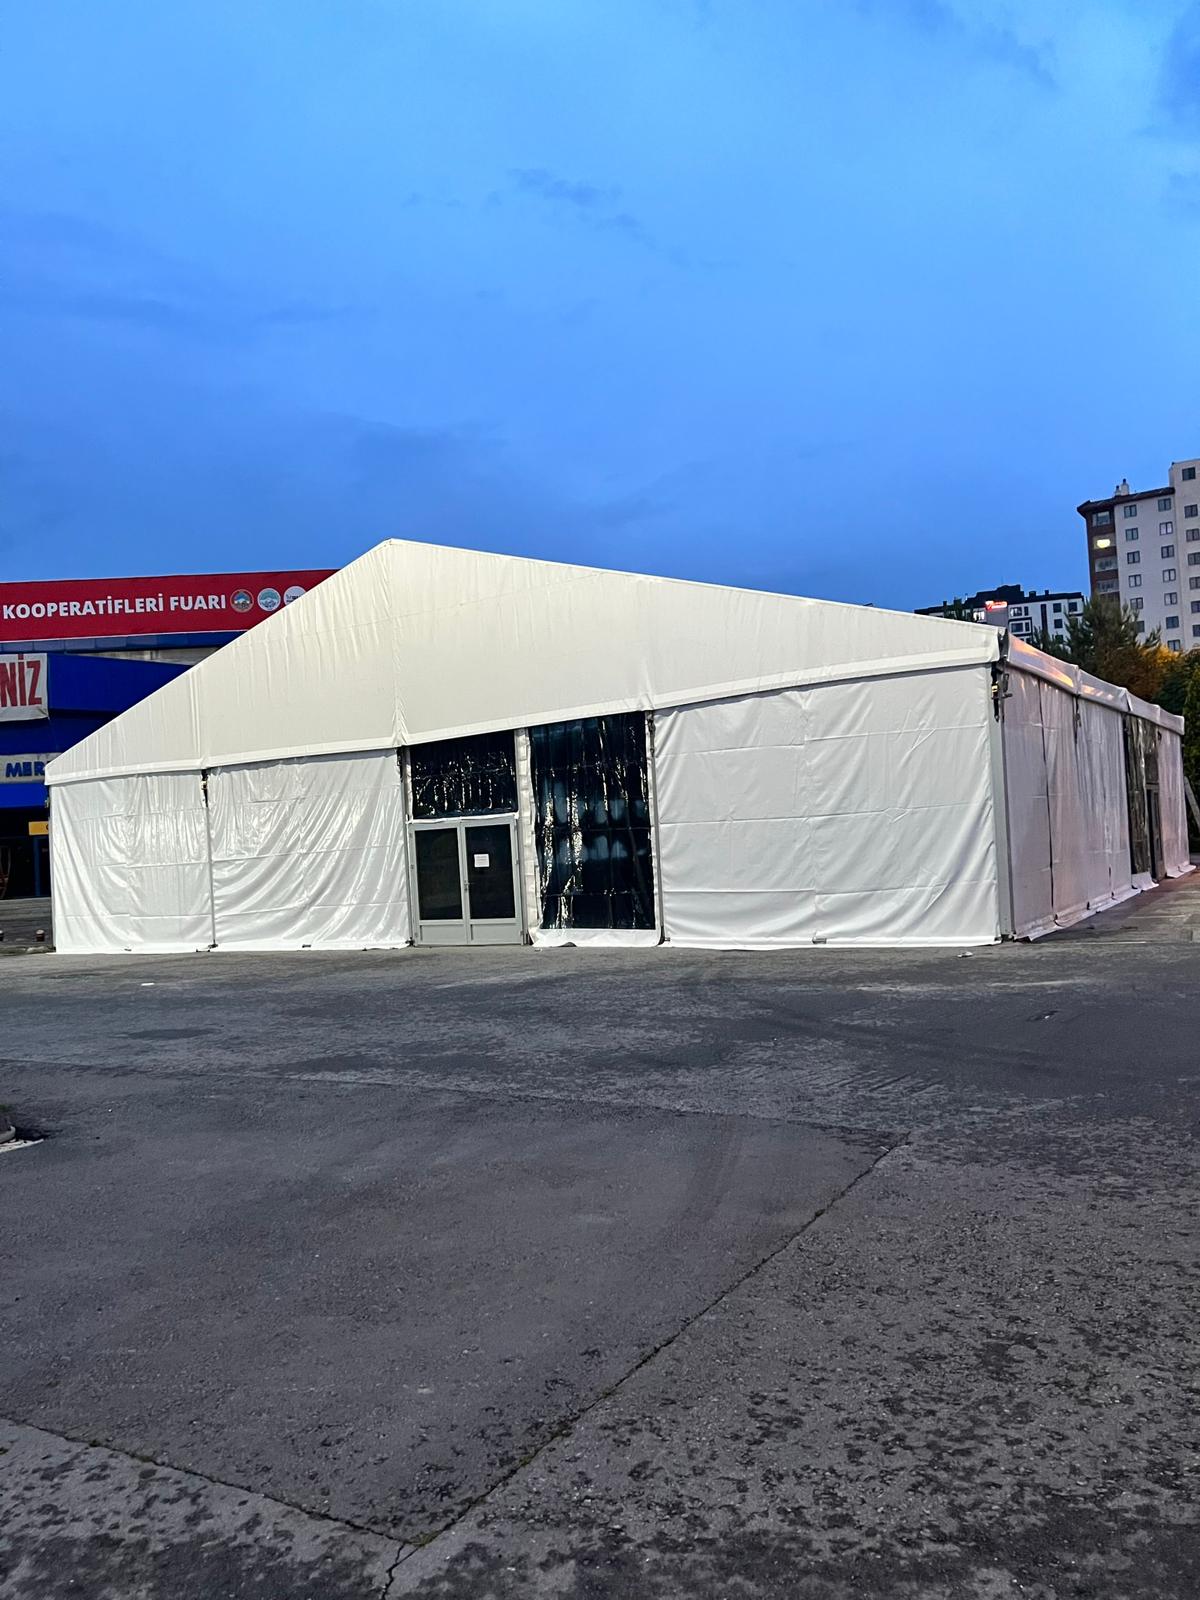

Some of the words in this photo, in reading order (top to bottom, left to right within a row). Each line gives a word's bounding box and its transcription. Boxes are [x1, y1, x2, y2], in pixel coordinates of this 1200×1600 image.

[3, 593, 164, 620] KOOPERATİFLERİ
[169, 594, 226, 611] FUARI
[5, 761, 49, 778] MER
